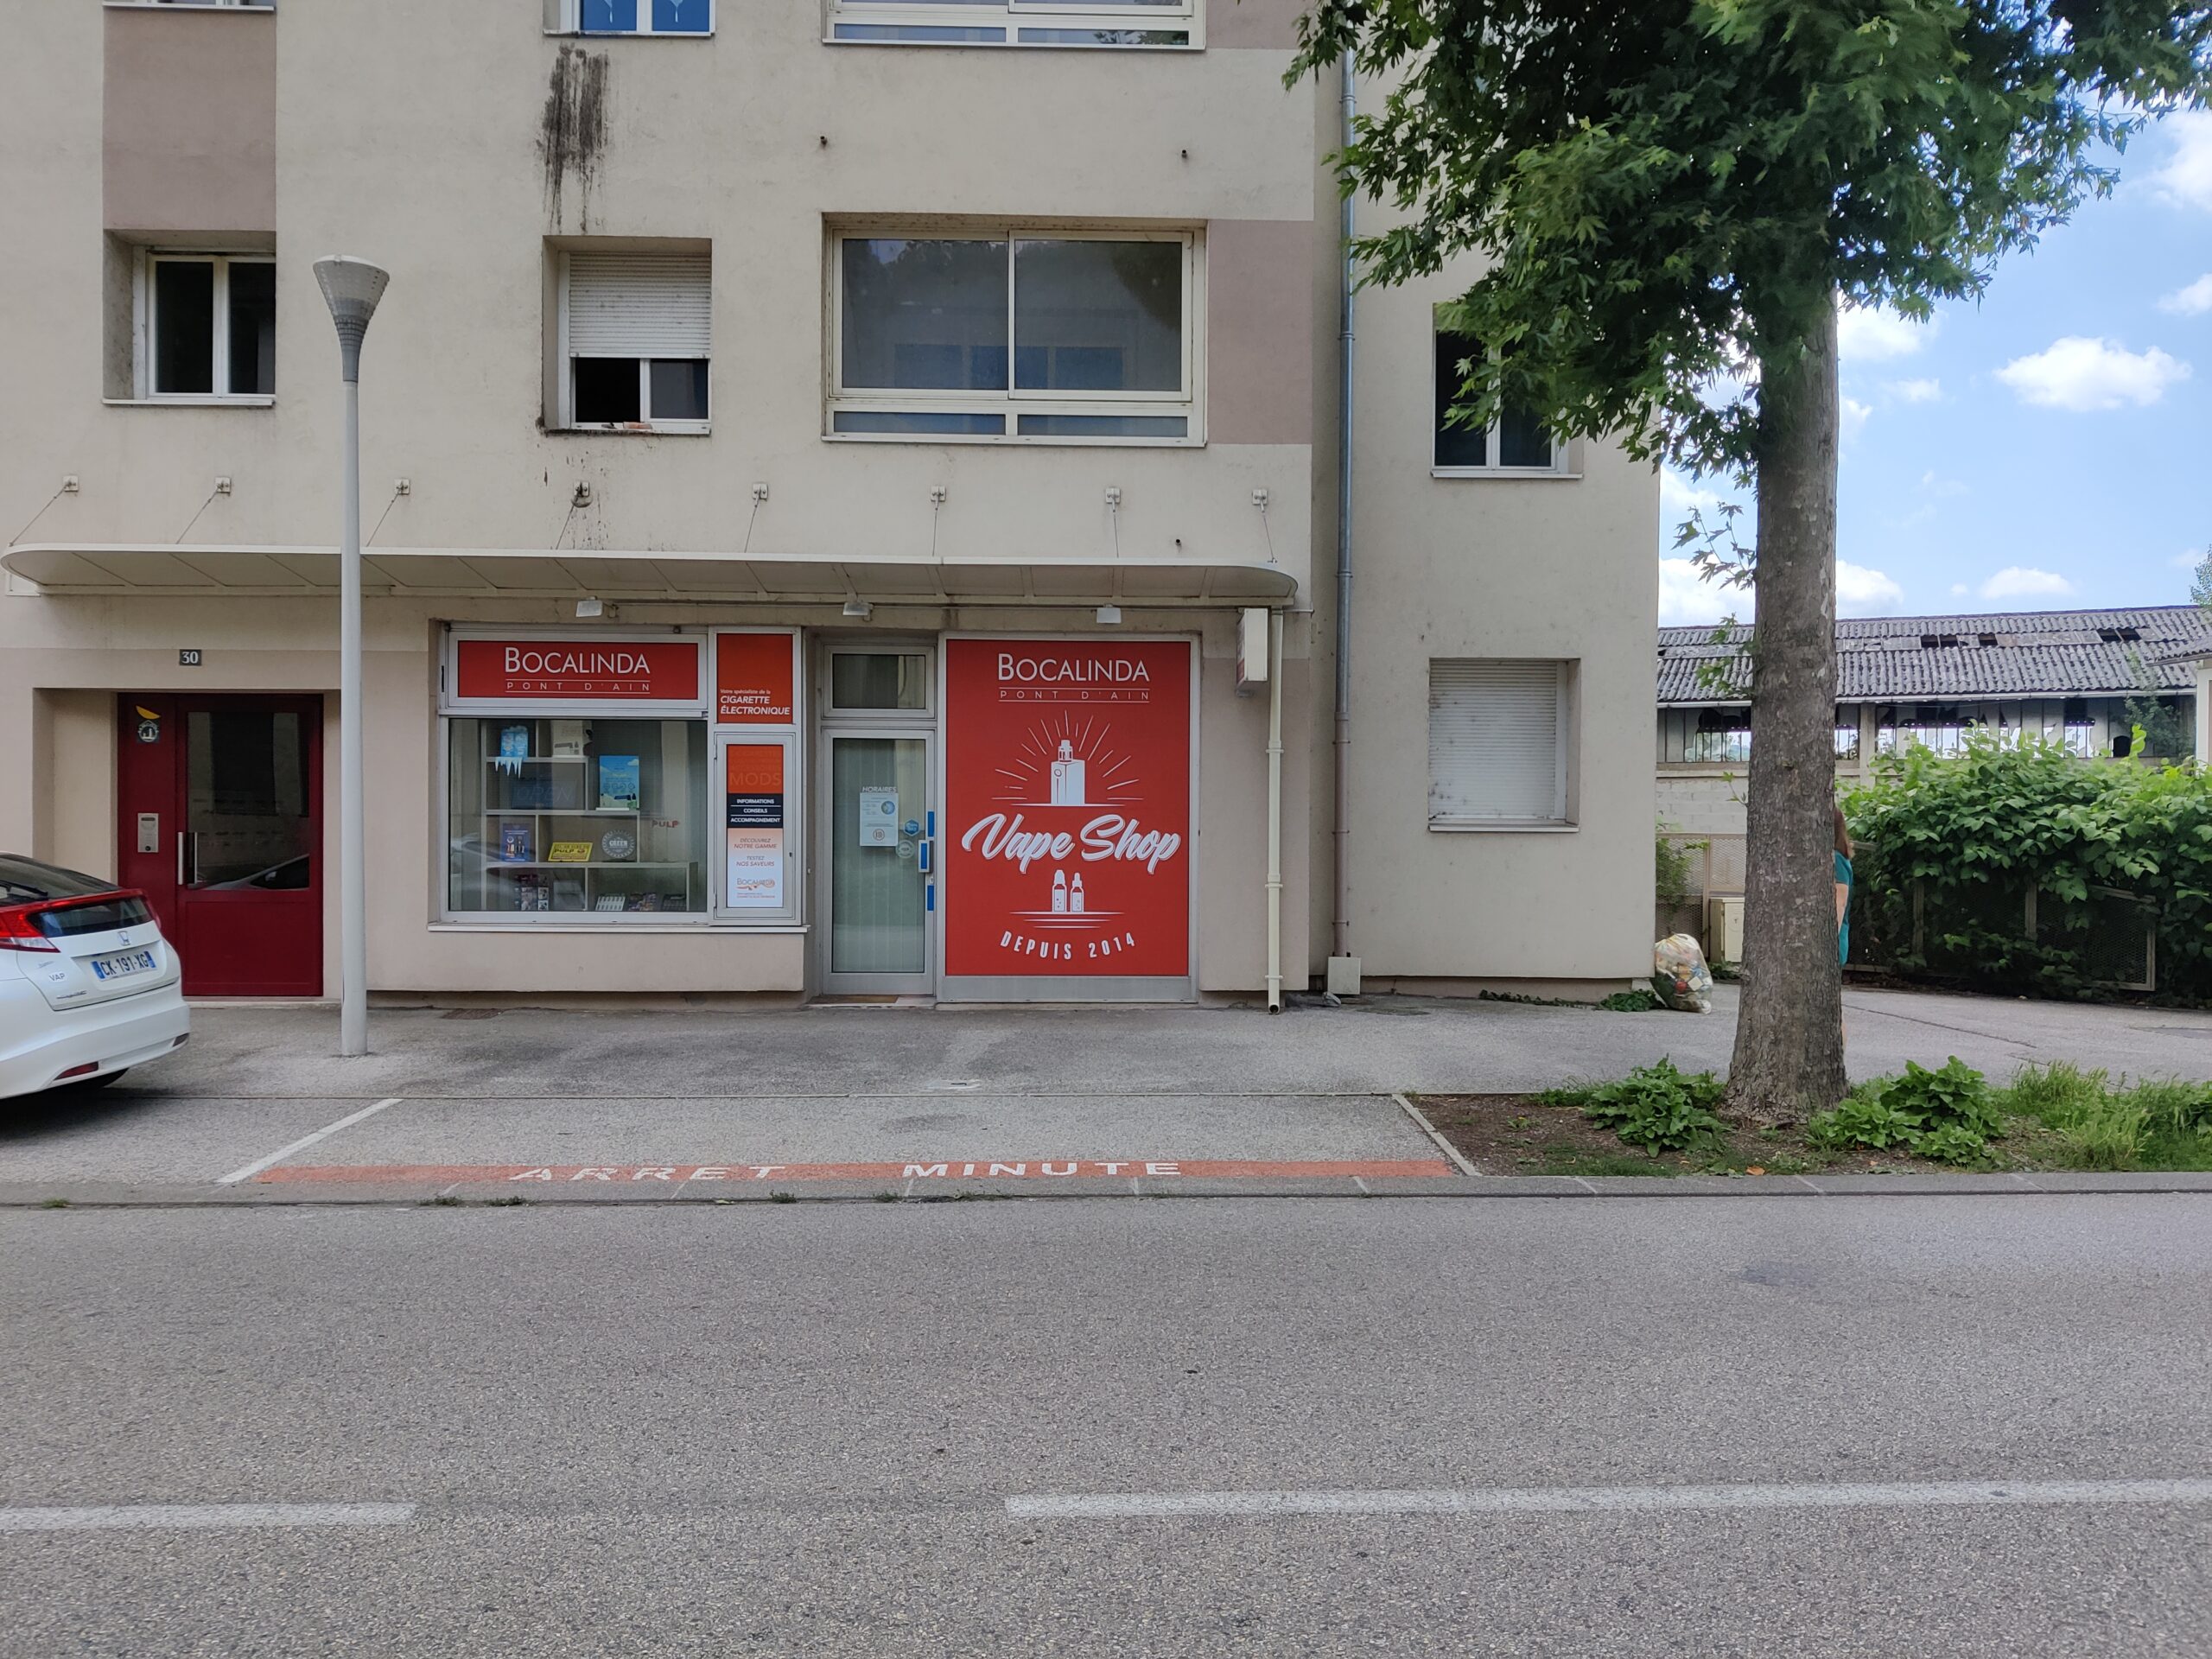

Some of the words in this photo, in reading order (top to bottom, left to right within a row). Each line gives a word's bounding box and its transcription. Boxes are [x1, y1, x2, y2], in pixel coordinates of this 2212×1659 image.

[181, 651, 199, 664] 30
[505, 646, 651, 674] BOCALINDA
[998, 652, 1150, 682] BOCALINDA
[506, 682, 563, 690] PONT
[584, 683, 650, 691] D'AIN
[720, 696, 771, 704] CIGARETTE
[1000, 690, 1058, 699] PONT
[1081, 691, 1148, 700] D'AIN
[720, 705, 791, 715] ÉLECTRONIQUE
[730, 772, 782, 786] MODS
[961, 813, 1076, 874] Vape
[1079, 814, 1181, 875] Shop
[1000, 931, 1072, 960] DEPUIS
[1088, 932, 1135, 958] 2014
[99, 953, 149, 976] CK-191-XG
[49, 973, 66, 982] VAP
[509, 1166, 785, 1181] ARRET
[901, 1162, 1182, 1178] MINUTE
